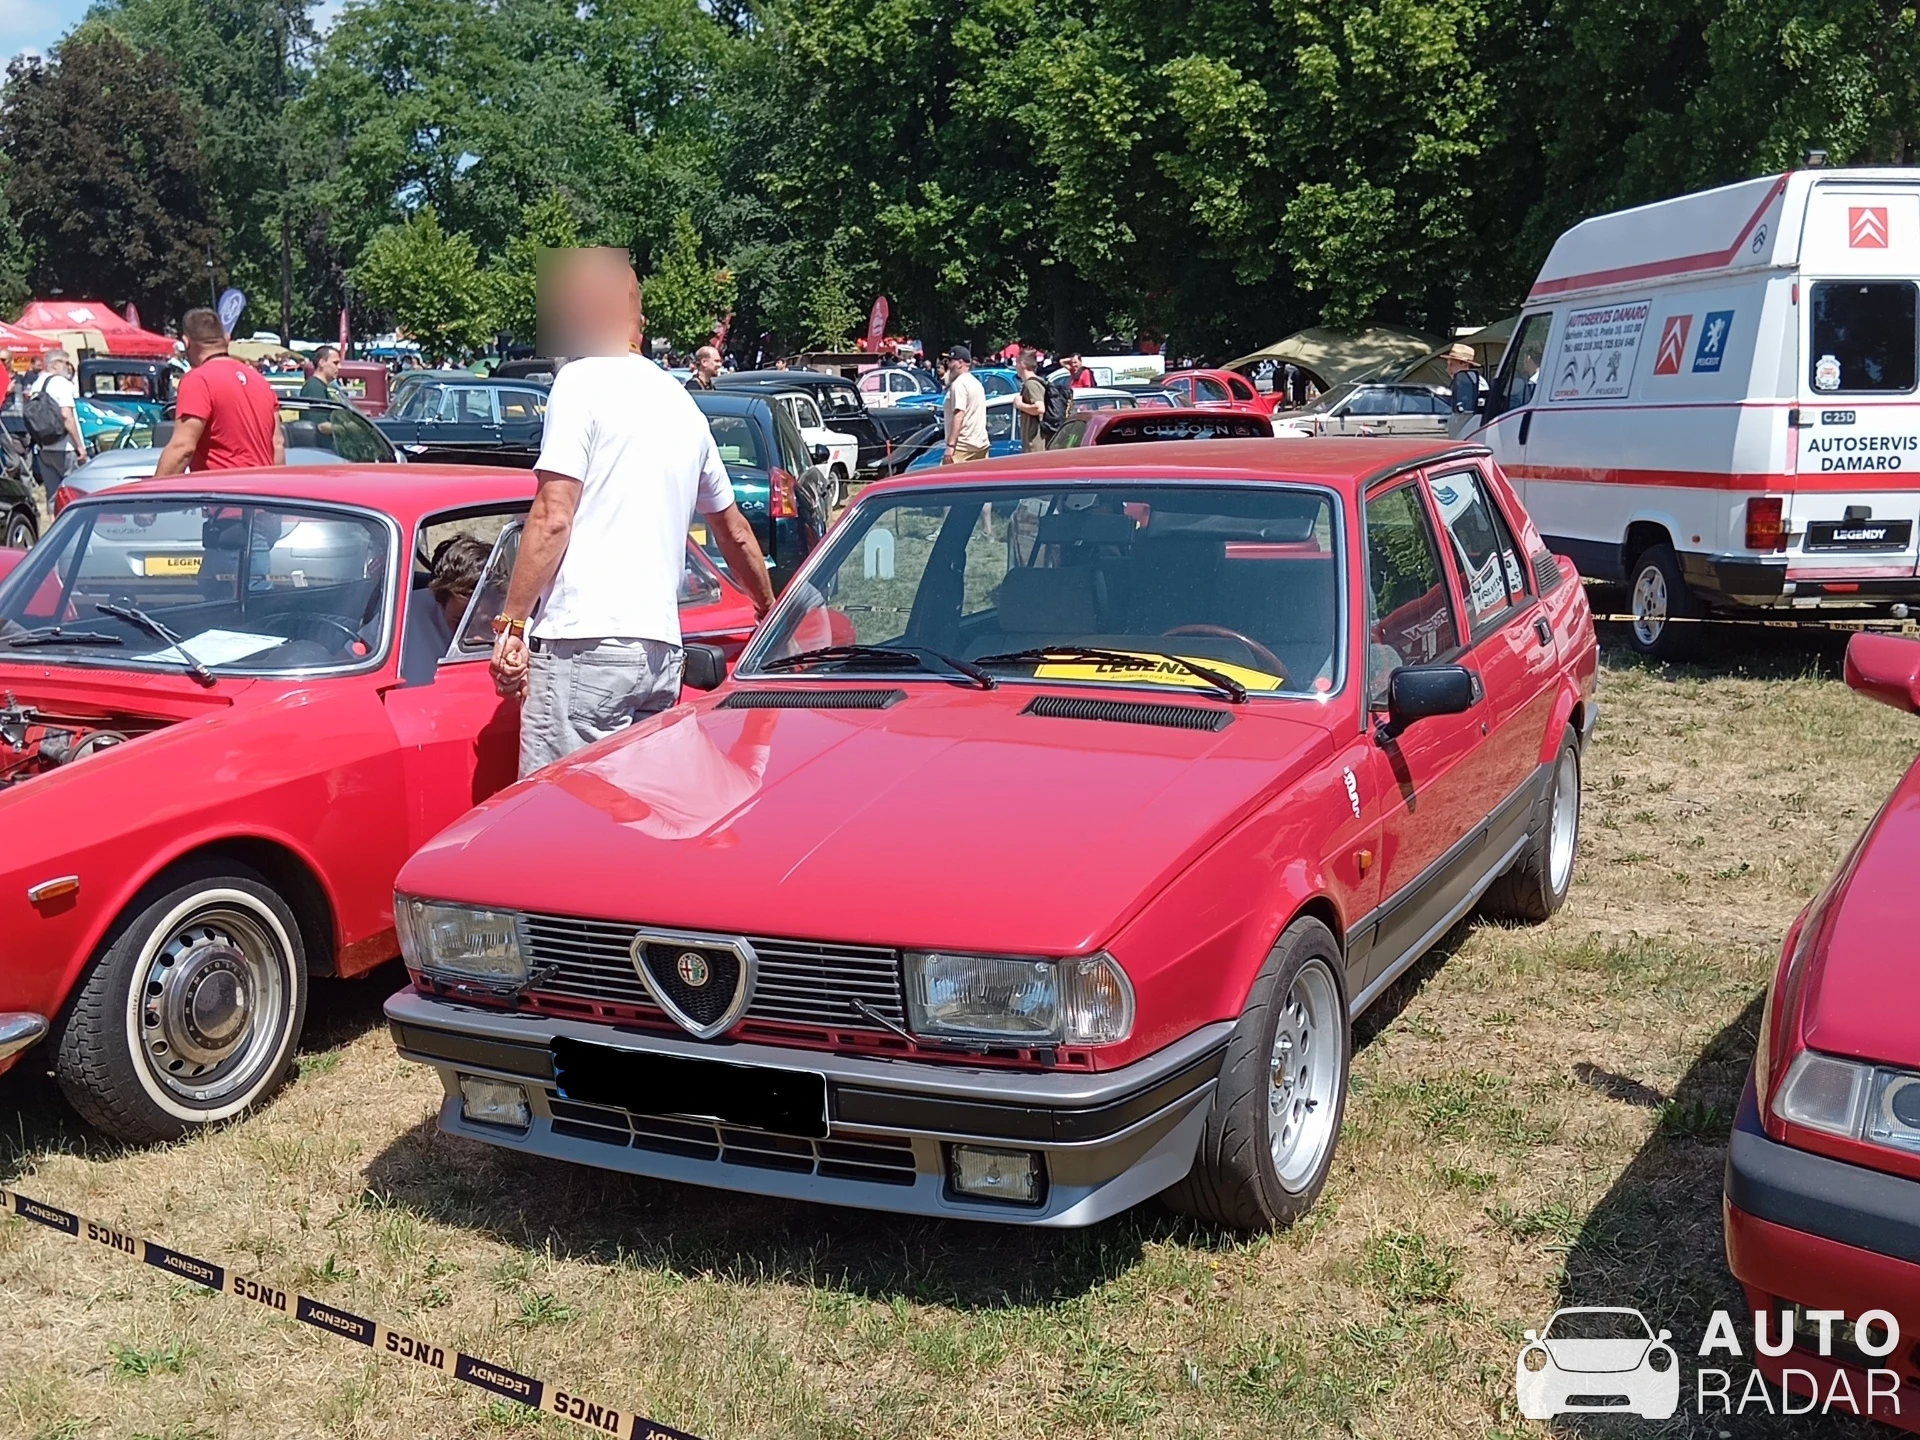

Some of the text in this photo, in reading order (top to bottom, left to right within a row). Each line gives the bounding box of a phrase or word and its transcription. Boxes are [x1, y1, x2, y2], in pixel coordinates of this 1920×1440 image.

[1566, 305, 1648, 328] AUTOSERVIS DAMARO
[1595, 387, 1624, 395] PEUGEOT
[1807, 436, 1918, 452] AUTOSERVIS
[1821, 456, 1902, 471] DAMARO
[1833, 529, 1886, 540] LEGENDY
[167, 558, 201, 567] LEGEN
[1095, 660, 1214, 676] LEGEN
[25, 1203, 70, 1228] LEGENDY
[88, 1223, 136, 1255] UNCS
[163, 1254, 214, 1281] LEGENDY
[234, 1276, 287, 1312] UNCS
[308, 1306, 364, 1336] LEGENDY
[386, 1331, 445, 1370] UNCS
[468, 1363, 531, 1396] LEGENDY
[553, 1391, 620, 1434] UNCS
